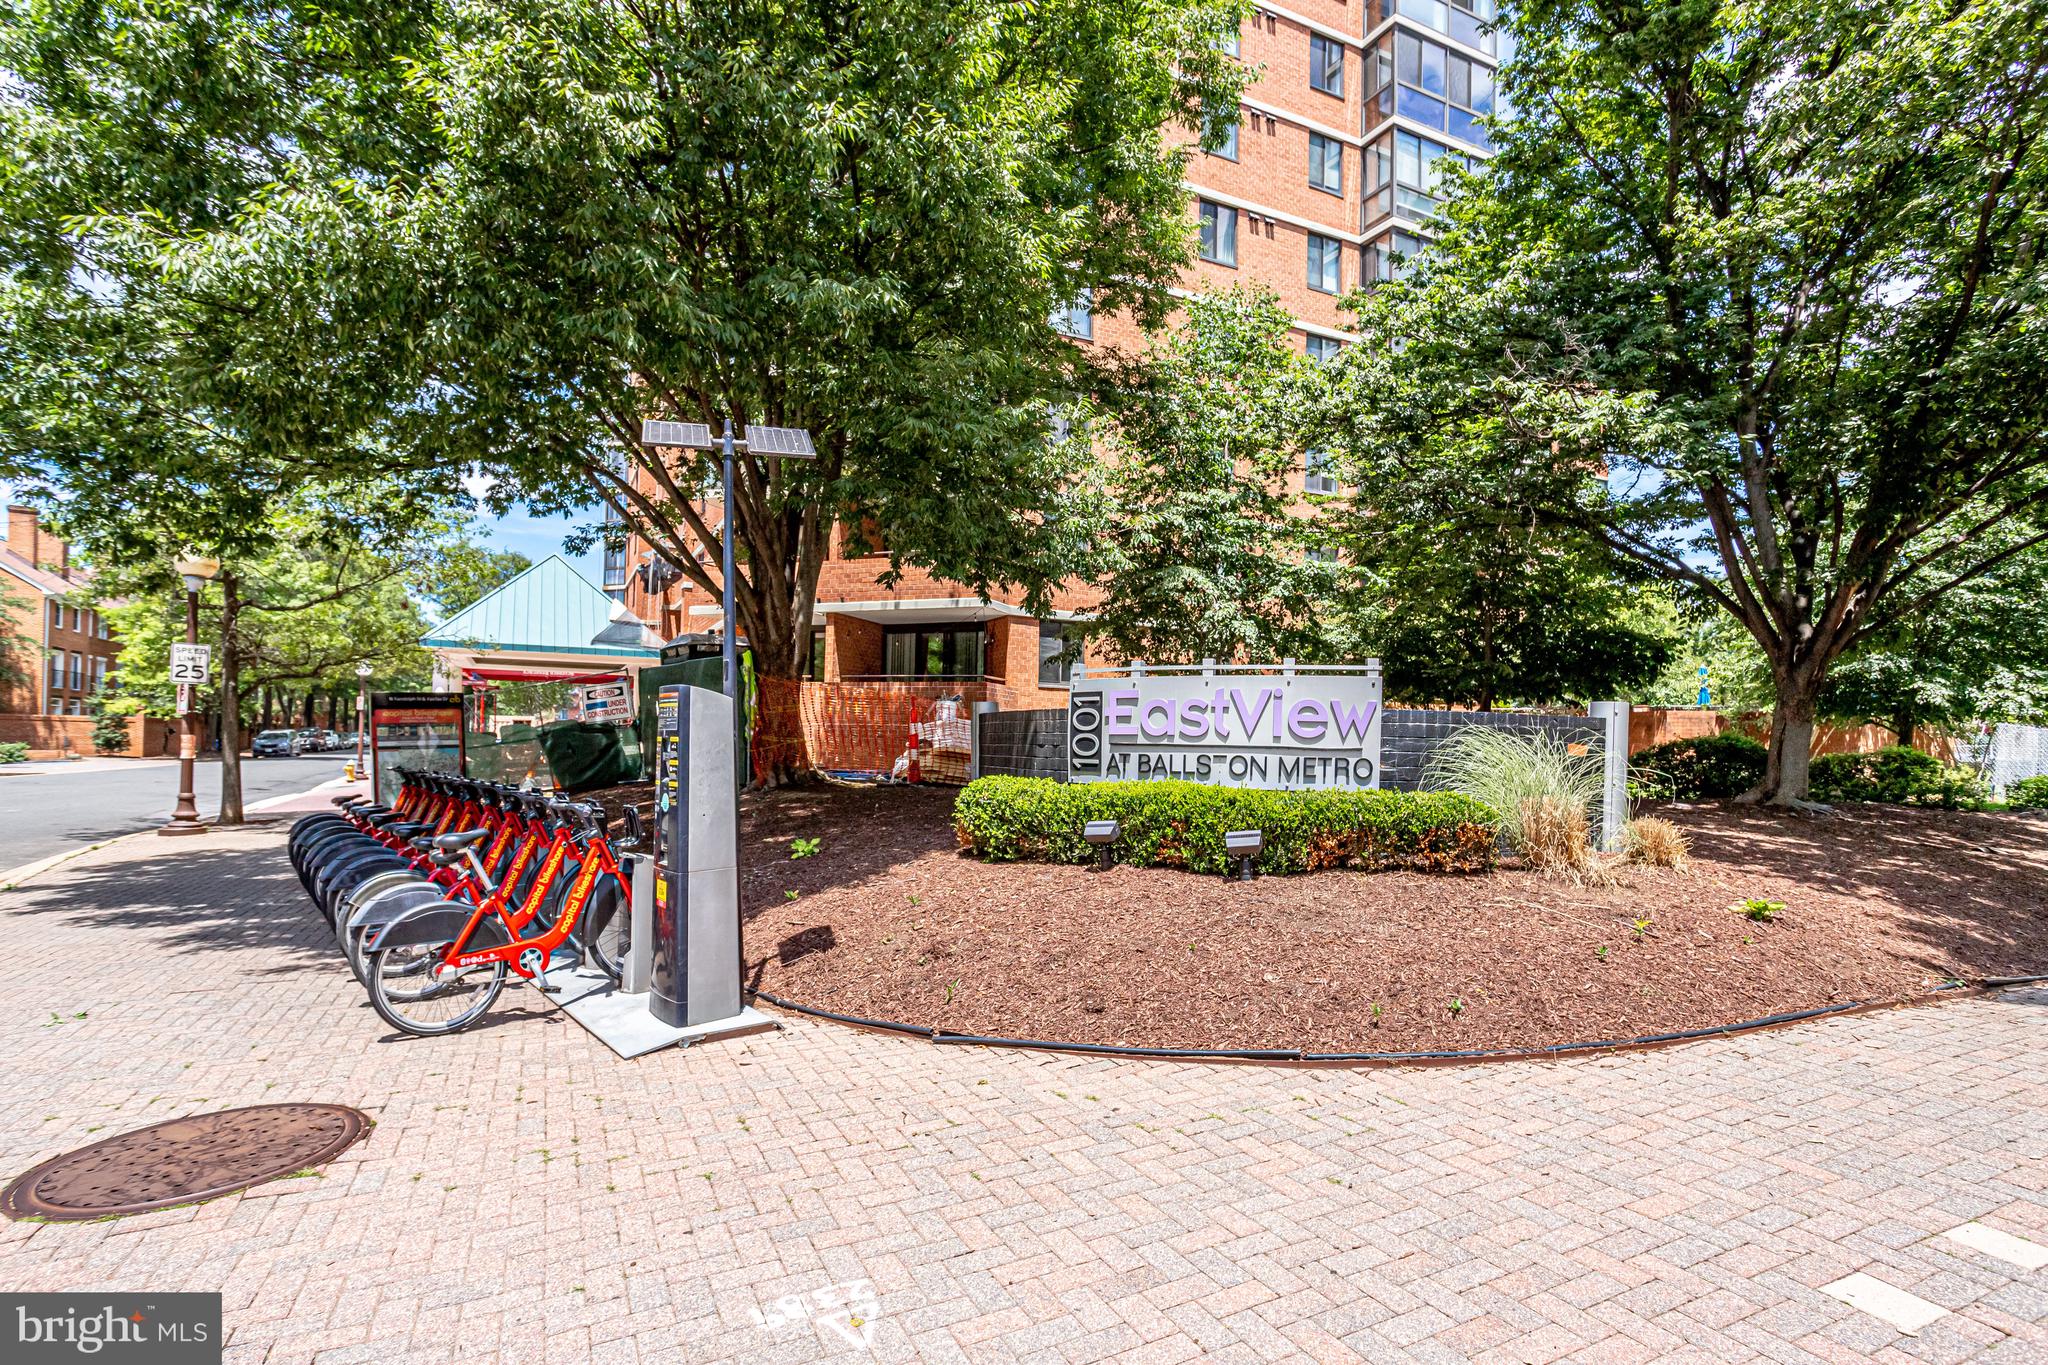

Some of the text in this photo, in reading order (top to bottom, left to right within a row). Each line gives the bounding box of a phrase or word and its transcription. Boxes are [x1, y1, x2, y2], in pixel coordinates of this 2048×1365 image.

[176, 647, 208, 655] SPEED
[178, 655, 202, 663] LIMIT
[175, 664, 204, 679] 25
[594, 688, 616, 698] CAUTION
[608, 698, 627, 708] UNDER
[587, 707, 628, 719] CONSTRUCTION
[1105, 688, 1377, 739] EastView
[1072, 696, 1101, 771] 1001
[1107, 754, 1130, 778] AT
[1279, 757, 1373, 784] METRO
[502, 835, 537, 898] capital bikeshare
[526, 846, 565, 915] capital bikeshare
[560, 857, 600, 933] capital bikeshare
